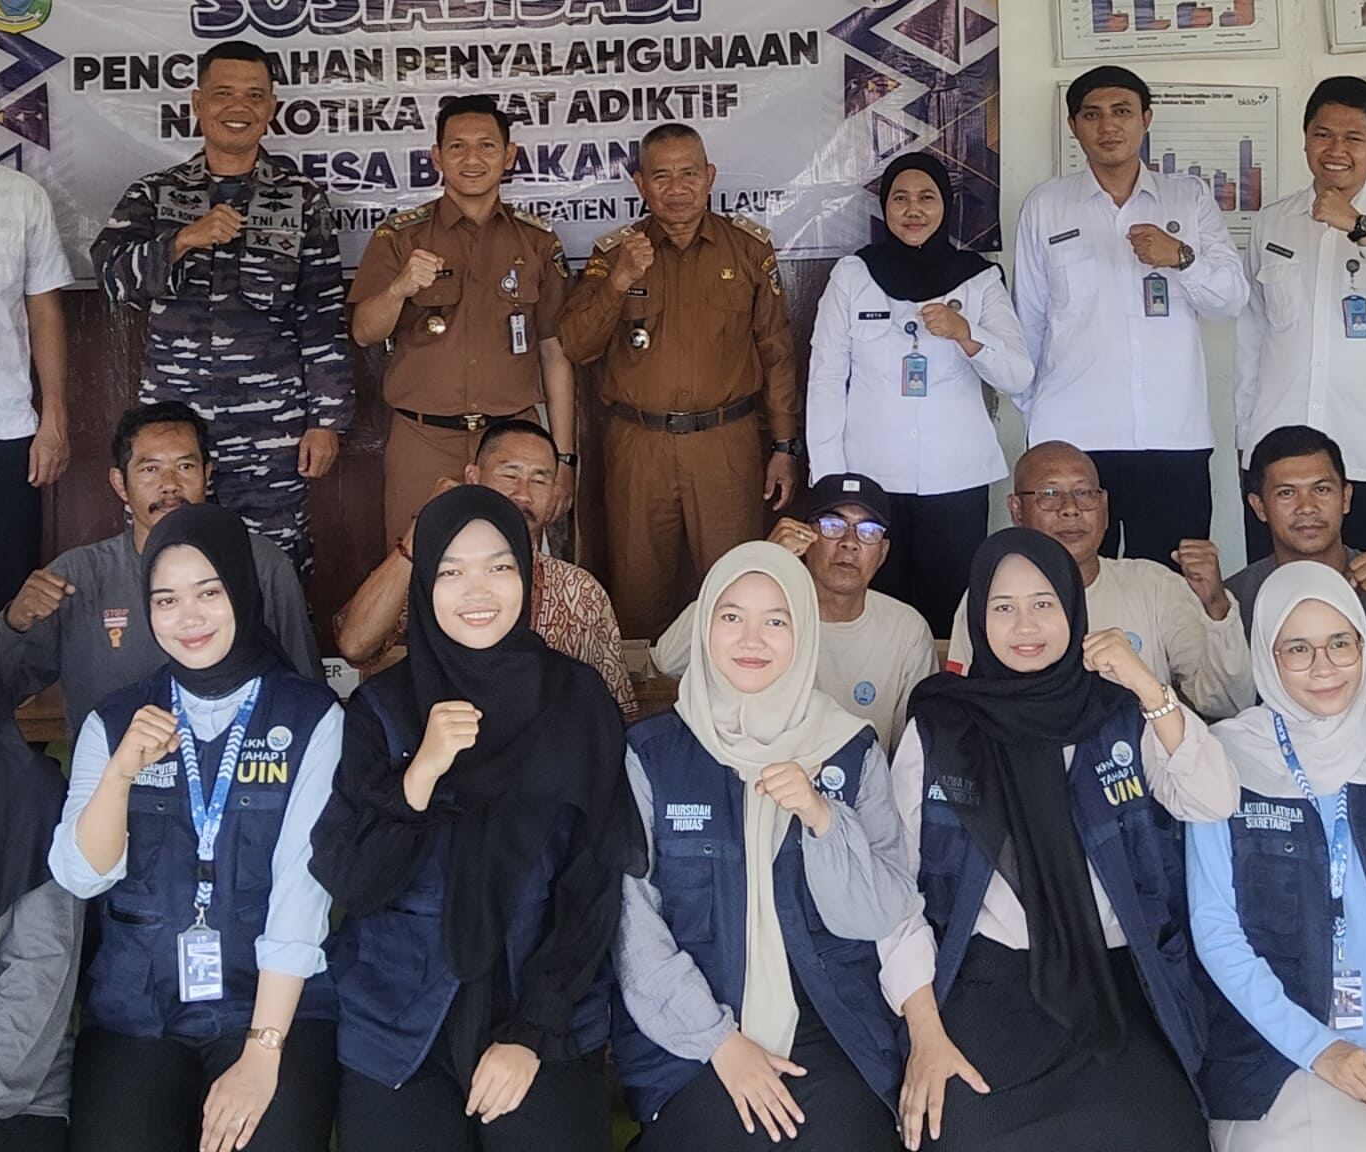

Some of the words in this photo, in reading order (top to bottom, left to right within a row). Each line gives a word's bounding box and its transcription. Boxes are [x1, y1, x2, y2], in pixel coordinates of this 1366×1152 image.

[73, 48, 383, 90] PENCAHAN
[396, 31, 818, 81] PENYALAHGUNAAN
[161, 97, 425, 138] NKOTIKA
[566, 84, 739, 125] ADIKTIF
[283, 149, 399, 192] DESA
[409, 139, 640, 190] BAKAN
[251, 215, 273, 226] TNI
[280, 217, 299, 228] AL
[241, 751, 280, 762] TAHAP
[281, 751, 287, 761] 1
[237, 761, 287, 784] UIN
[1099, 767, 1130, 786] TAHAP
[1129, 766, 1135, 776] 1
[1103, 775, 1144, 806] UIN
[666, 803, 711, 817] MURSIDAH
[673, 818, 704, 832] HUMAS
[1245, 816, 1292, 833] SEKRETARIS
